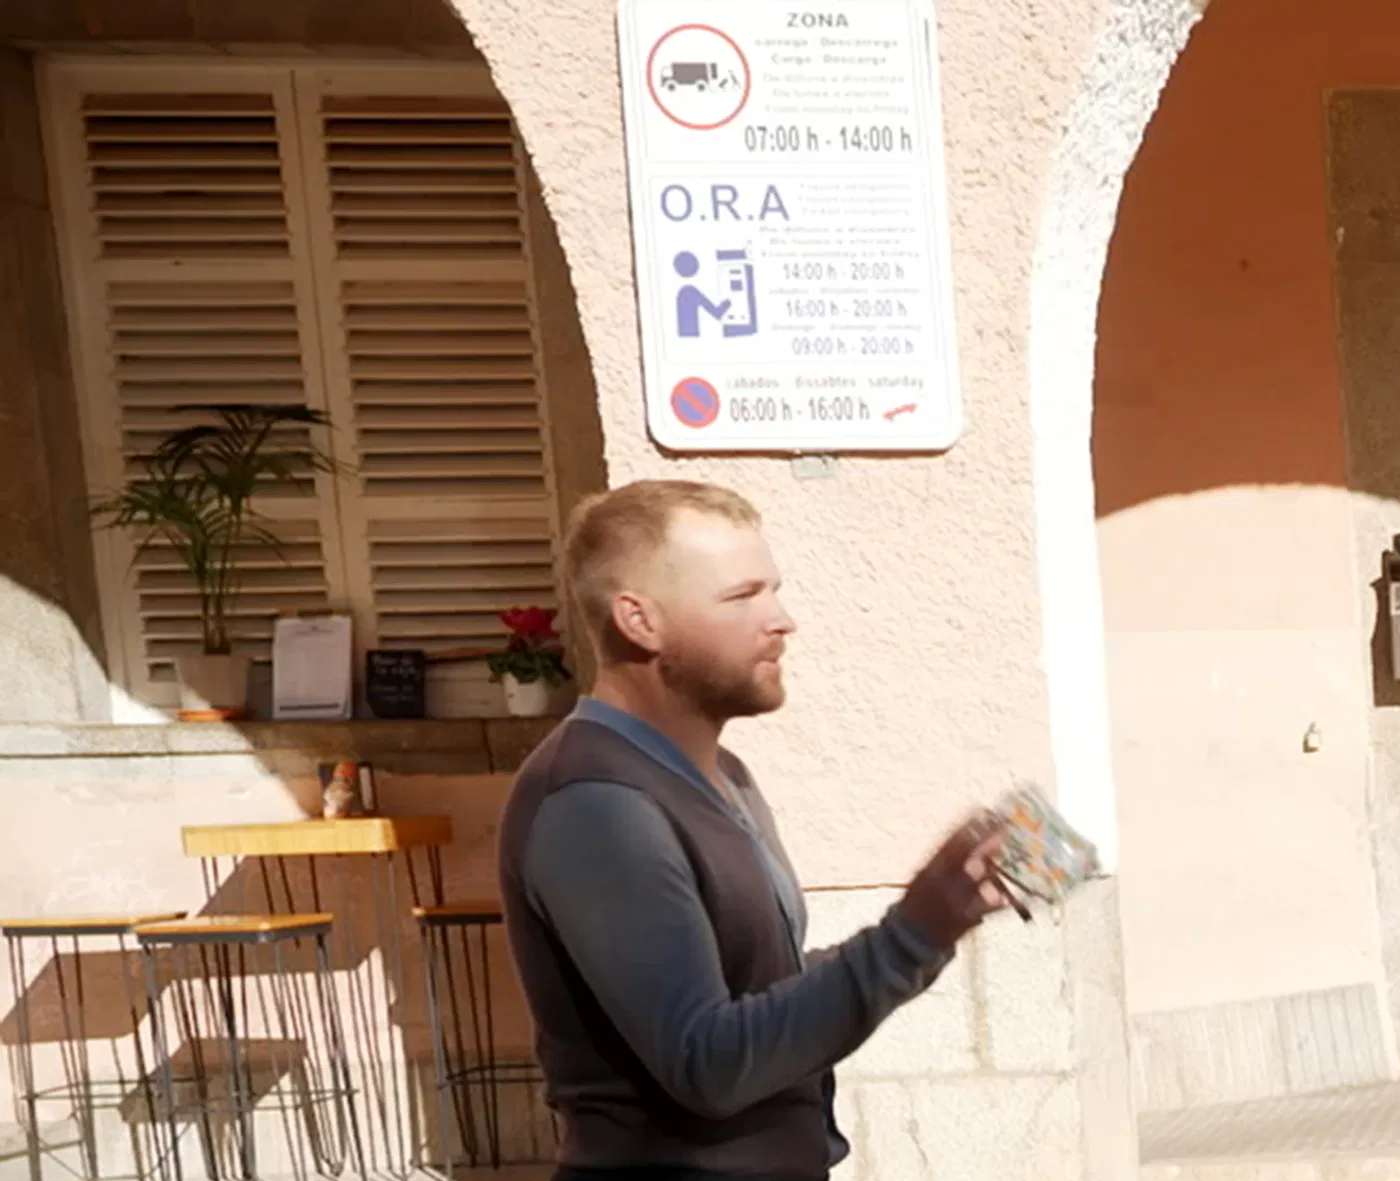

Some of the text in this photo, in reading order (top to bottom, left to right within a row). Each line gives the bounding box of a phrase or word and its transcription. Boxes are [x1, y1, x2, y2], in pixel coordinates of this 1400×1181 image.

[787, 12, 849, 28] ZONA
[744, 124, 801, 152] 07:00
[806, 125, 819, 151] h
[840, 125, 893, 152] 14:00
[900, 125, 913, 153] h
[660, 184, 790, 222] O.R.A
[730, 396, 778, 422] 06:00
[781, 397, 792, 420] h
[808, 396, 854, 421] 16:00
[858, 397, 870, 420] h
